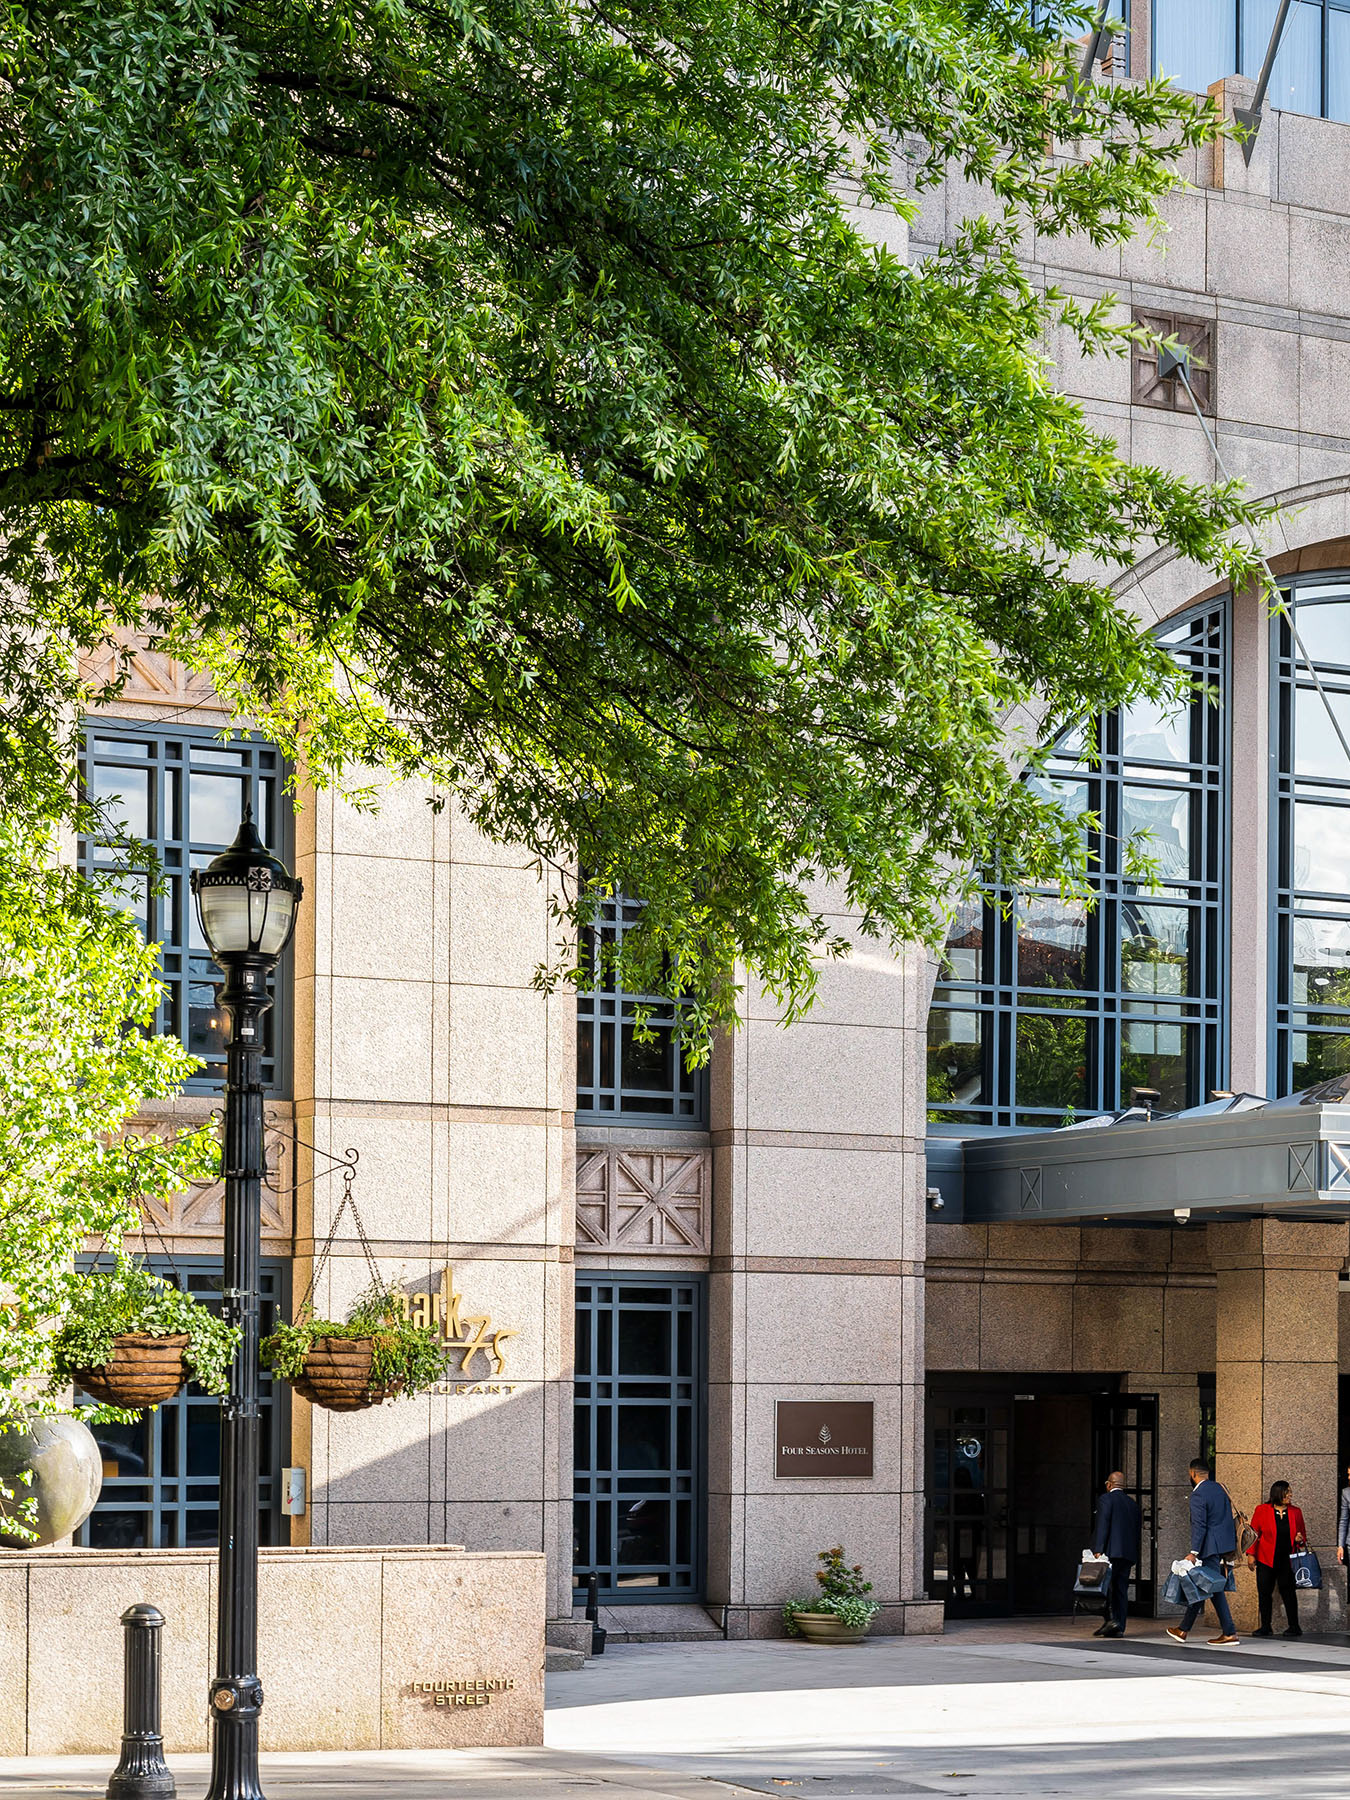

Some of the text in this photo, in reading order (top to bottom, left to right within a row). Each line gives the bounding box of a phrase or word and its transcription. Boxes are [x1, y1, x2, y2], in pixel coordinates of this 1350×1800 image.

[422, 1384, 516, 1395] AURANT
[781, 1445, 869, 1455] FOUR SEASONS HOTEL
[412, 1679, 516, 1693] FOURTEENTH
[435, 1693, 496, 1706] STREET
